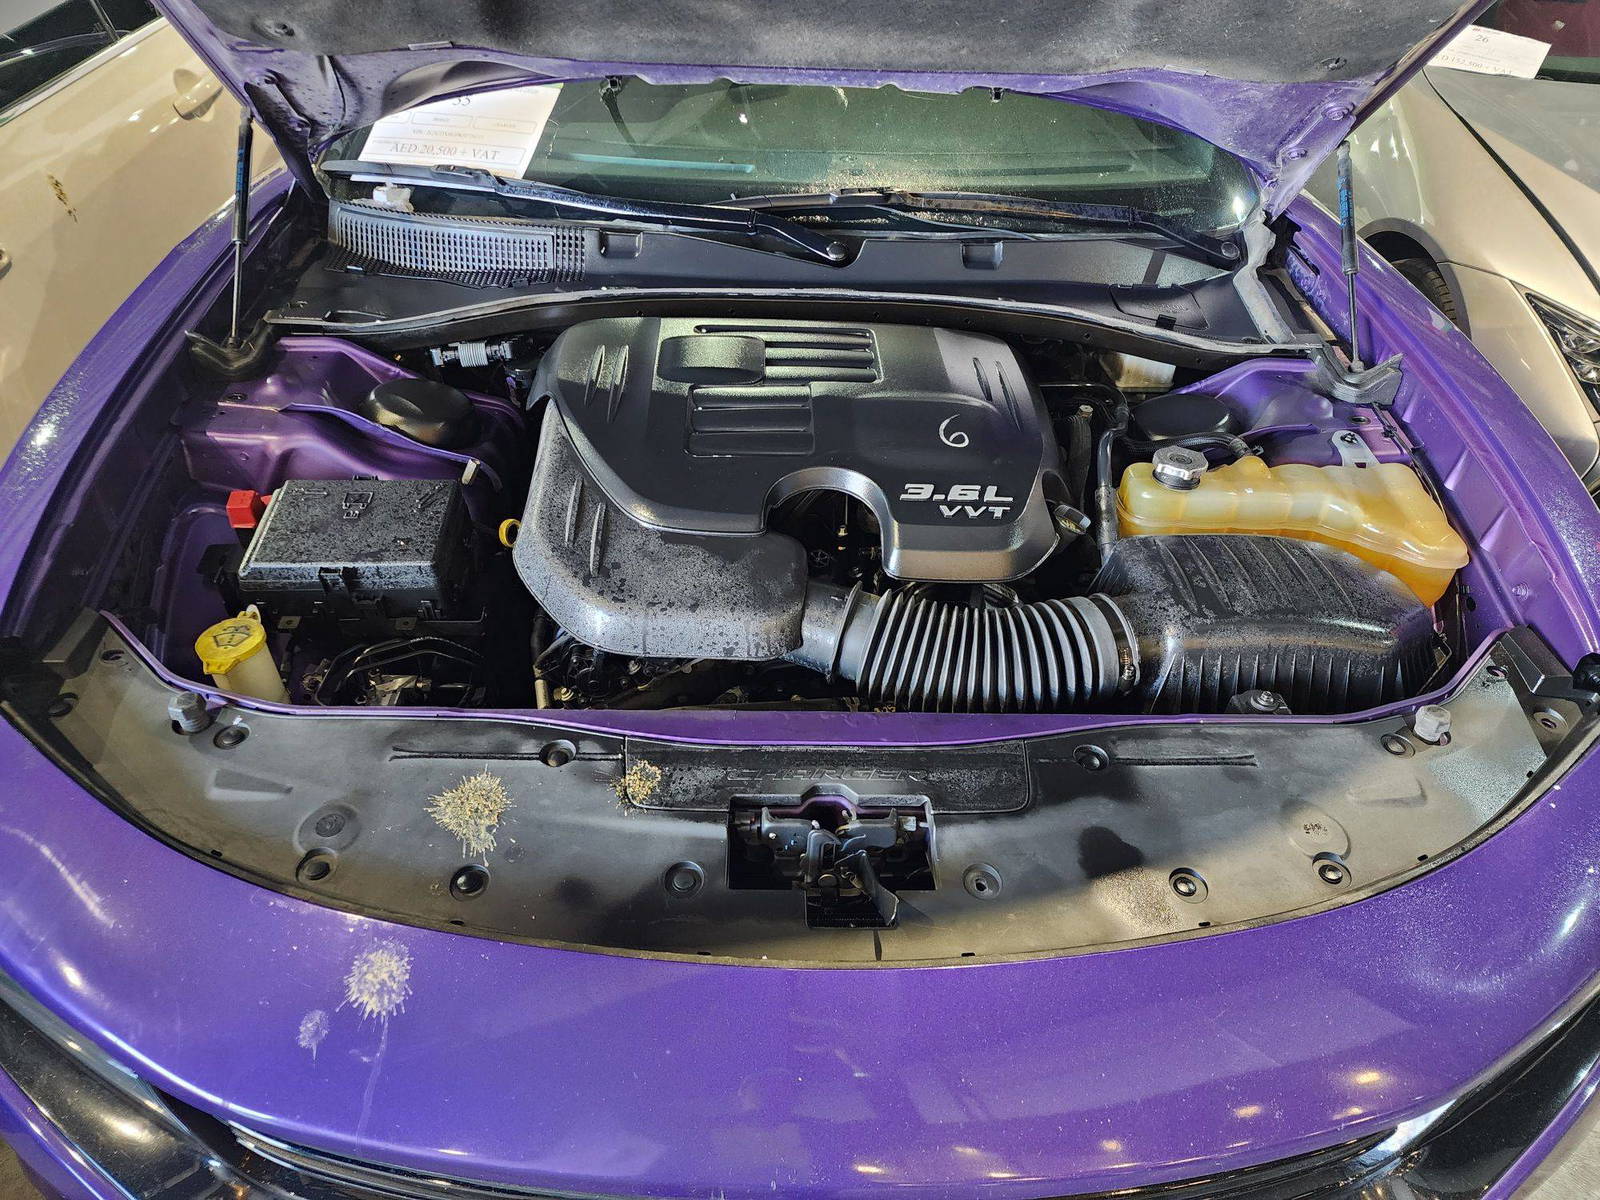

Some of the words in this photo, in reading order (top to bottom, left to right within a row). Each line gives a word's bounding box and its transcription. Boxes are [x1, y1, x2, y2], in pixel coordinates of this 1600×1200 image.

[390, 143, 417, 154] AED
[471, 148, 501, 160] VAT
[938, 413, 970, 448] 6
[900, 483, 1014, 502] 3.6L
[938, 505, 1011, 520] VVT
[726, 768, 926, 782] CHARGER
